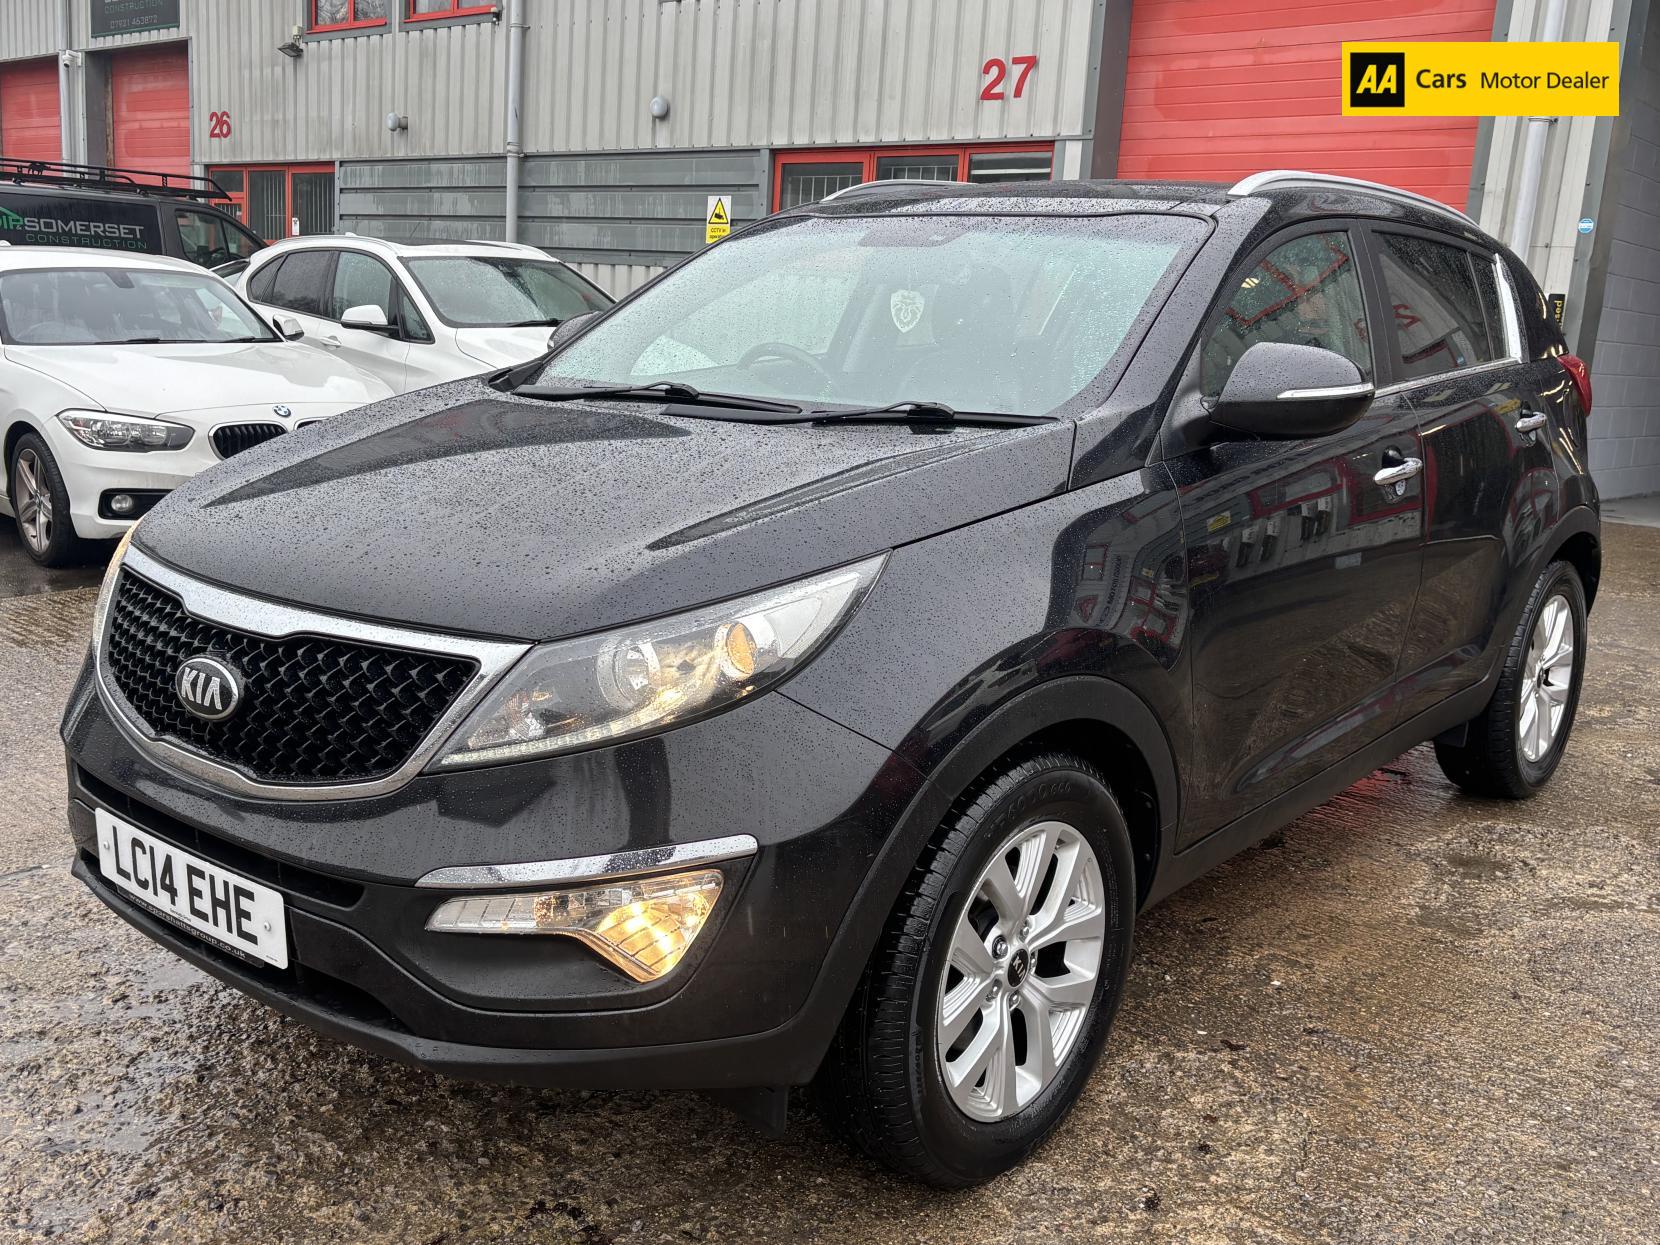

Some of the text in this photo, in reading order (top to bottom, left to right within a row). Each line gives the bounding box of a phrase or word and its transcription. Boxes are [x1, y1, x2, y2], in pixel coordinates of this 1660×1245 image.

[980, 56, 1037, 100] 27
[210, 111, 231, 138] 26
[24, 217, 144, 239] SOMERSET
[26, 233, 147, 249] CONSTRUCTION
[181, 667, 222, 710] KIA
[112, 825, 258, 946] LC14 EHE
